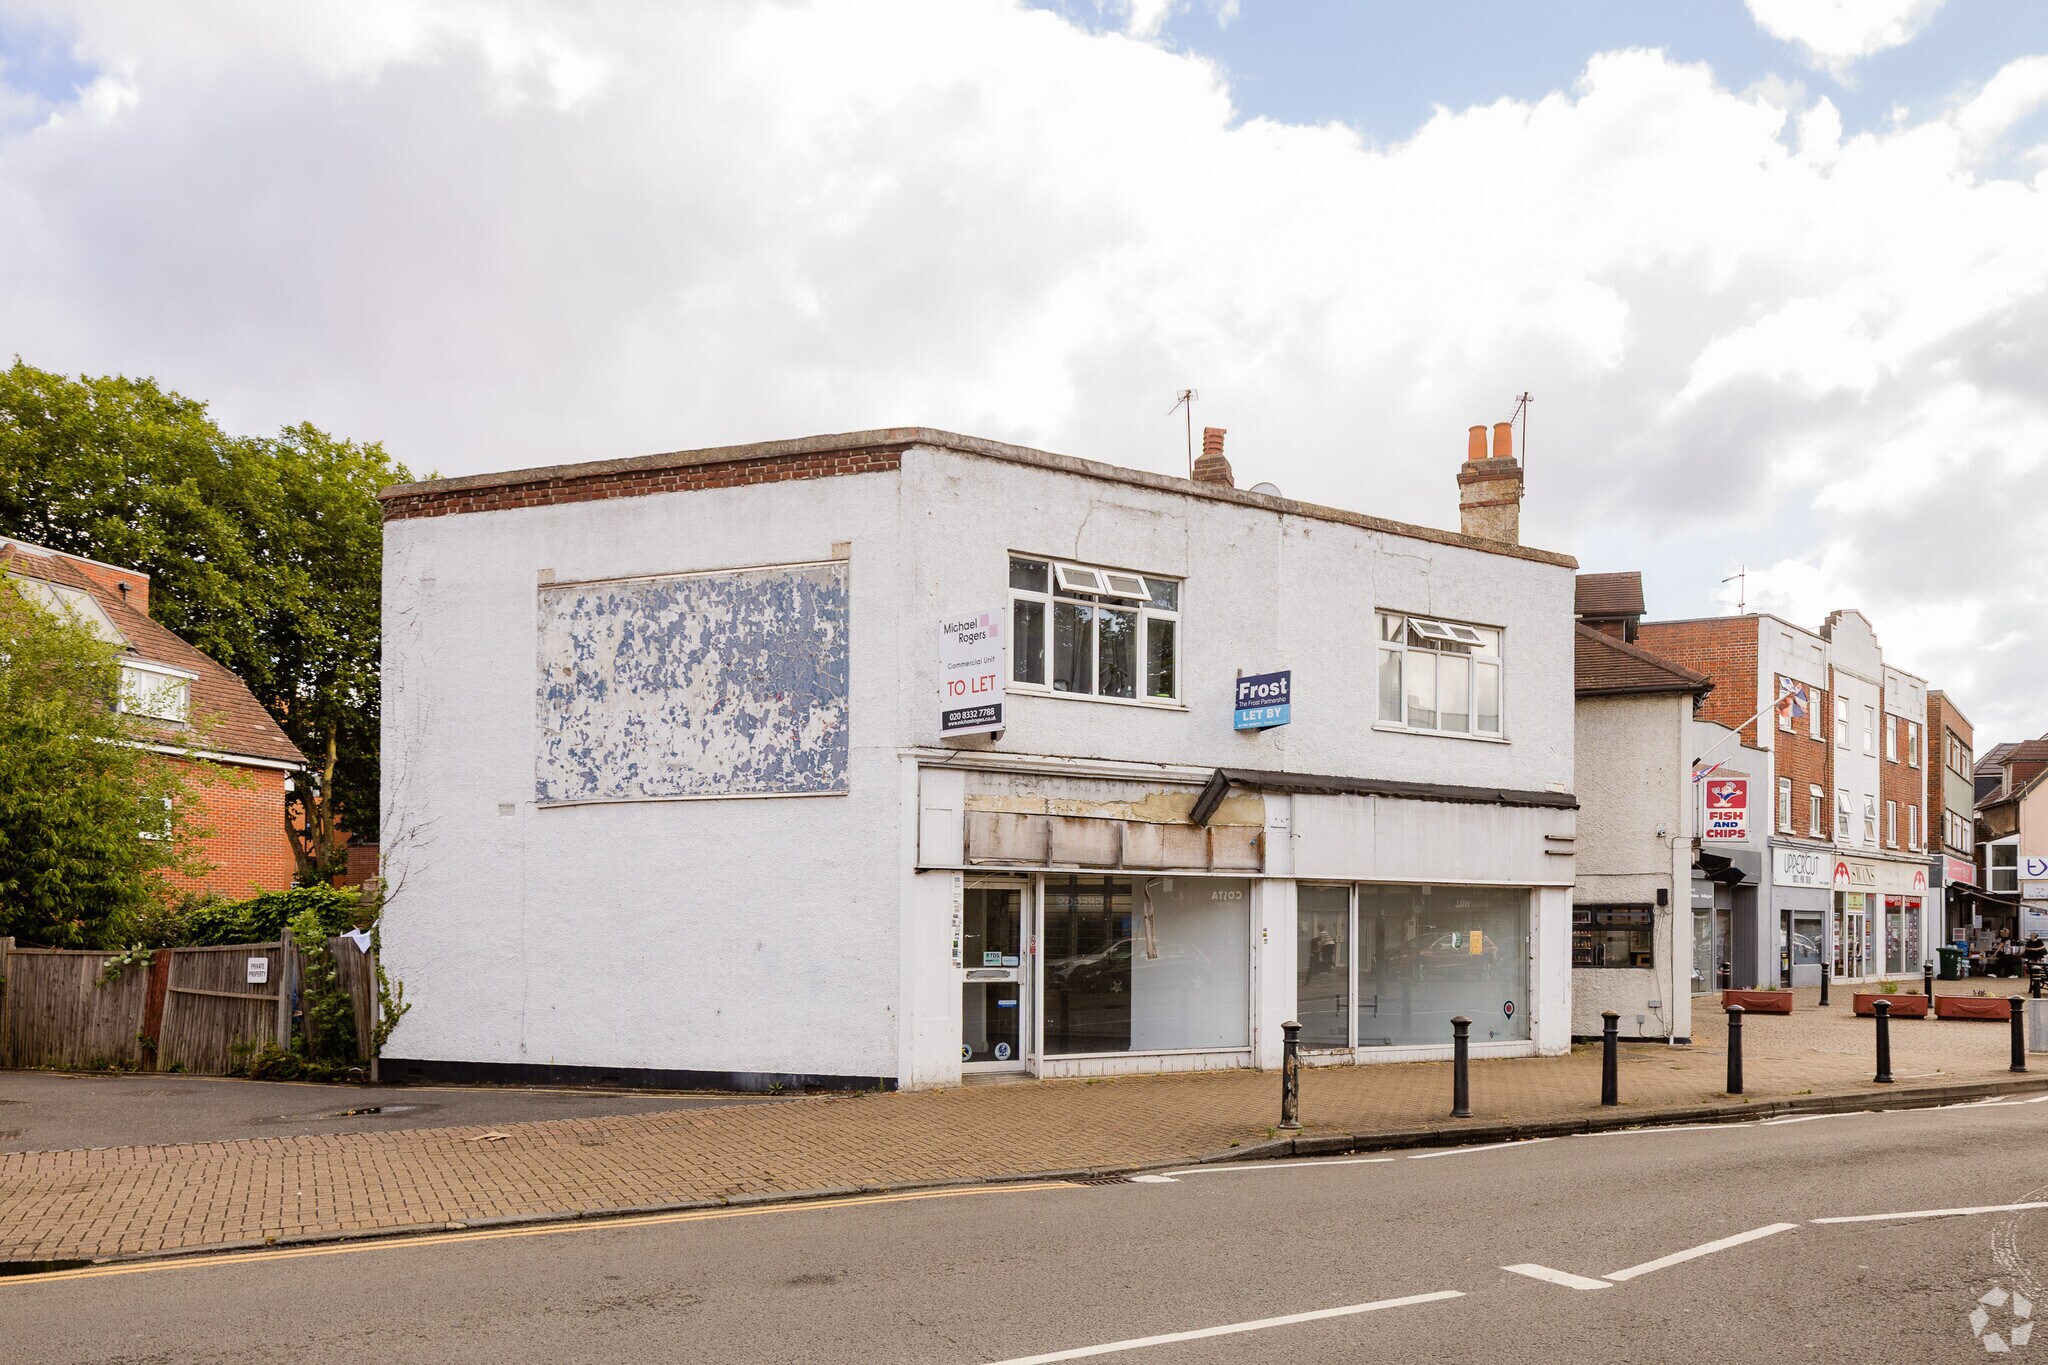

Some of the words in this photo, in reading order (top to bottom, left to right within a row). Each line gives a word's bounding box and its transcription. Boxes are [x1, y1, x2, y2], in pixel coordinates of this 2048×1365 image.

[944, 618, 978, 634] Michael
[958, 631, 986, 645] Rogers
[948, 658, 982, 669] Commercial
[984, 656, 995, 664] Unit
[947, 680, 966, 696] TO
[971, 675, 996, 693] LET
[1239, 678, 1287, 700] Frost
[1261, 697, 1287, 705] Partnership
[949, 712, 961, 721] 020
[962, 710, 978, 719] 8332
[978, 707, 995, 716] 7788
[1242, 710, 1263, 720] LET
[1266, 707, 1281, 718] BY
[1709, 812, 1743, 820] FISH
[1706, 829, 1746, 838] CHIPS
[1784, 853, 1819, 875] UPPERCUT
